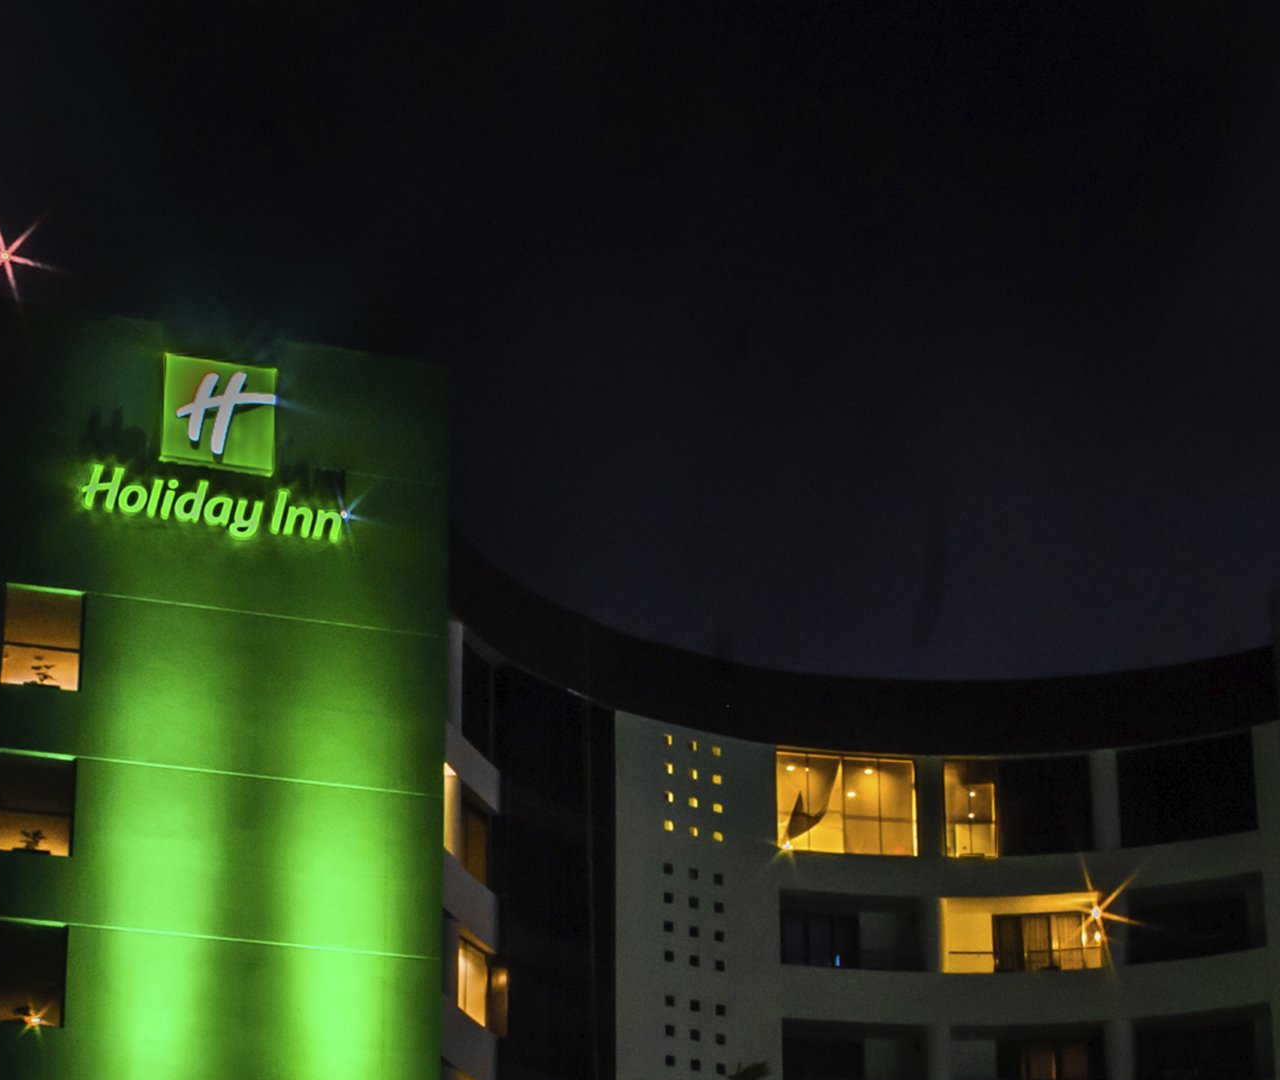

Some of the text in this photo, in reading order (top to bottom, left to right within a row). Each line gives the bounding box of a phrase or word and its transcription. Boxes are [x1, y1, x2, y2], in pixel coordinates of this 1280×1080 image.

[176, 371, 277, 454] H
[81, 463, 342, 543] Holiday Inn
